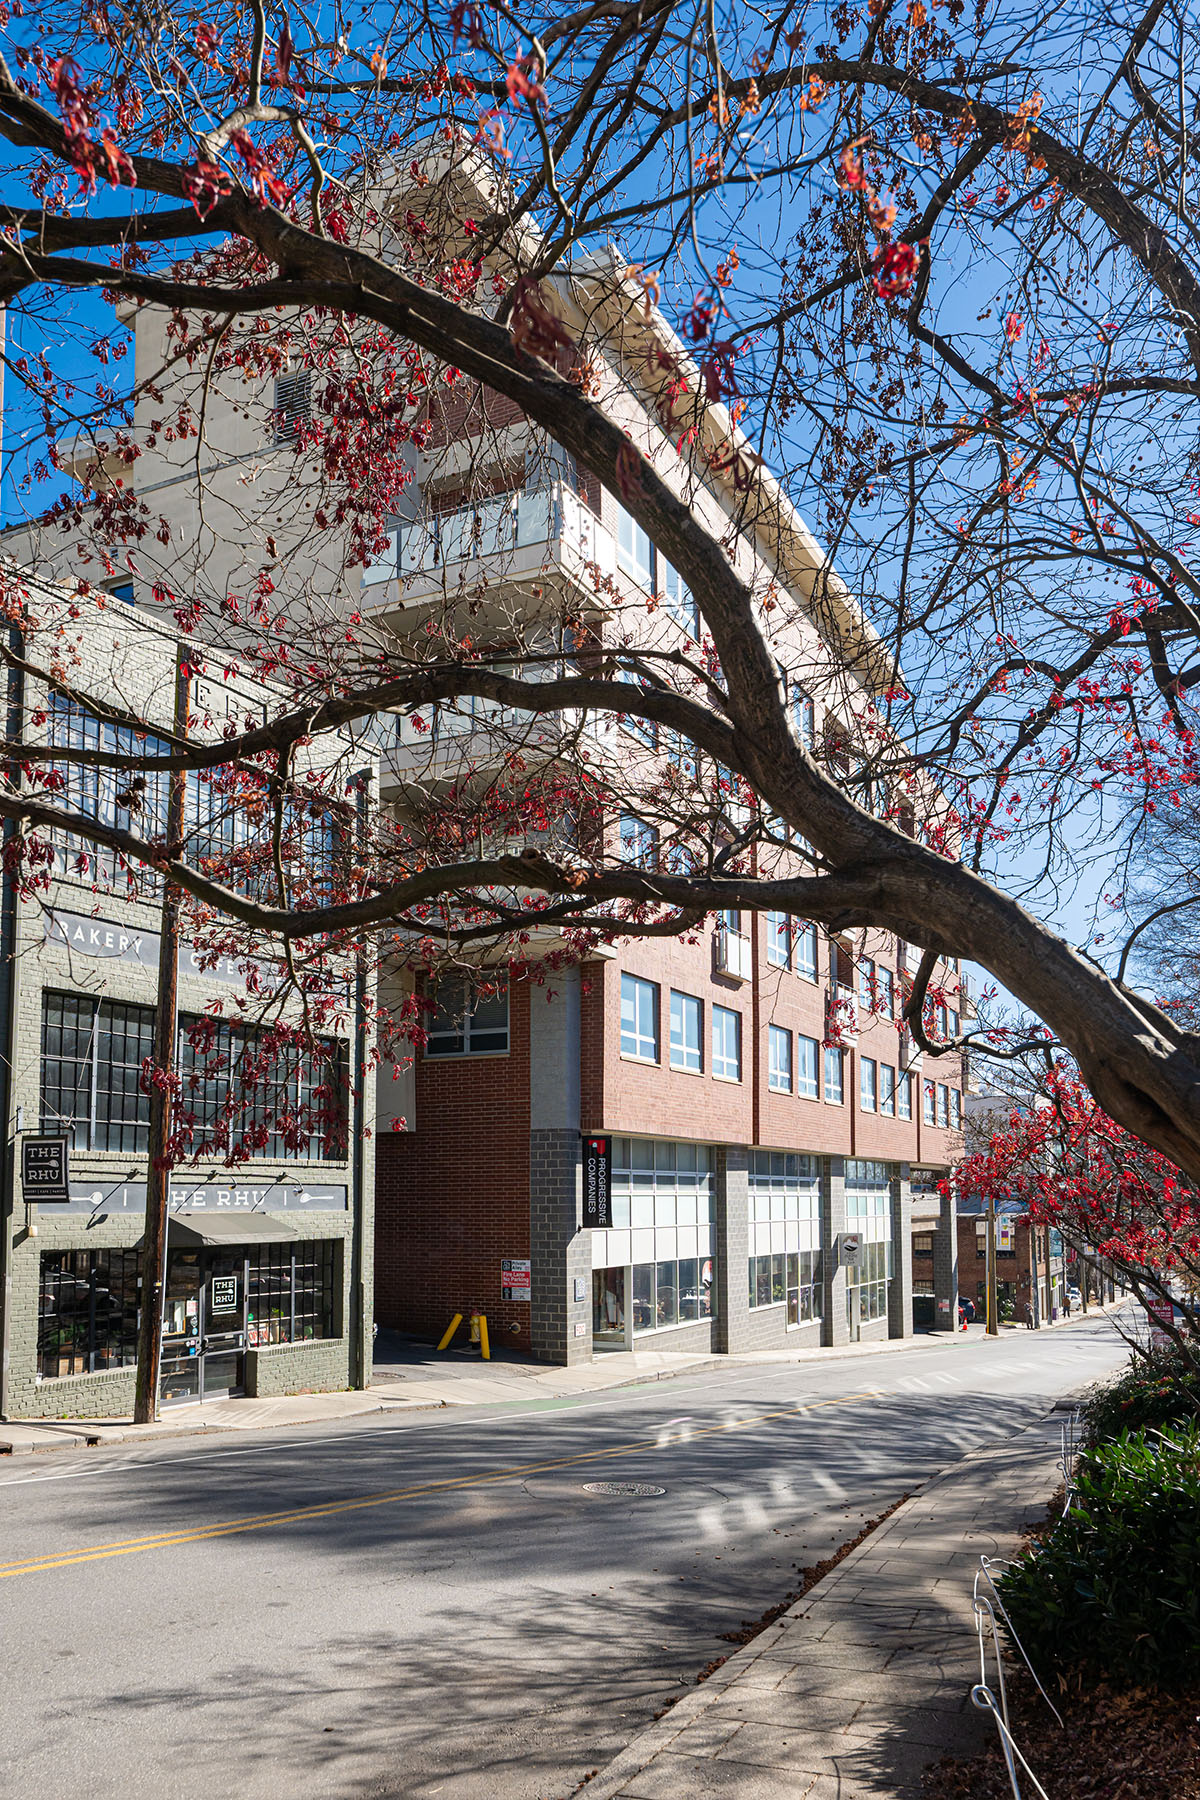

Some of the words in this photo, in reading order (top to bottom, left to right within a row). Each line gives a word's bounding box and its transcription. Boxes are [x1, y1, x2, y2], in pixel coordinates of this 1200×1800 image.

[59, 920, 143, 954] BAKERY
[28, 1147, 60, 1158] THE
[28, 1170, 60, 1180] RHU
[587, 1157, 597, 1214] COMPANIES
[598, 1157, 607, 1225] PROGRESSIVE
[171, 1190, 207, 1207] HE
[217, 1190, 266, 1206] RHU
[215, 1281, 234, 1289] THE
[215, 1295, 234, 1304] RHU
